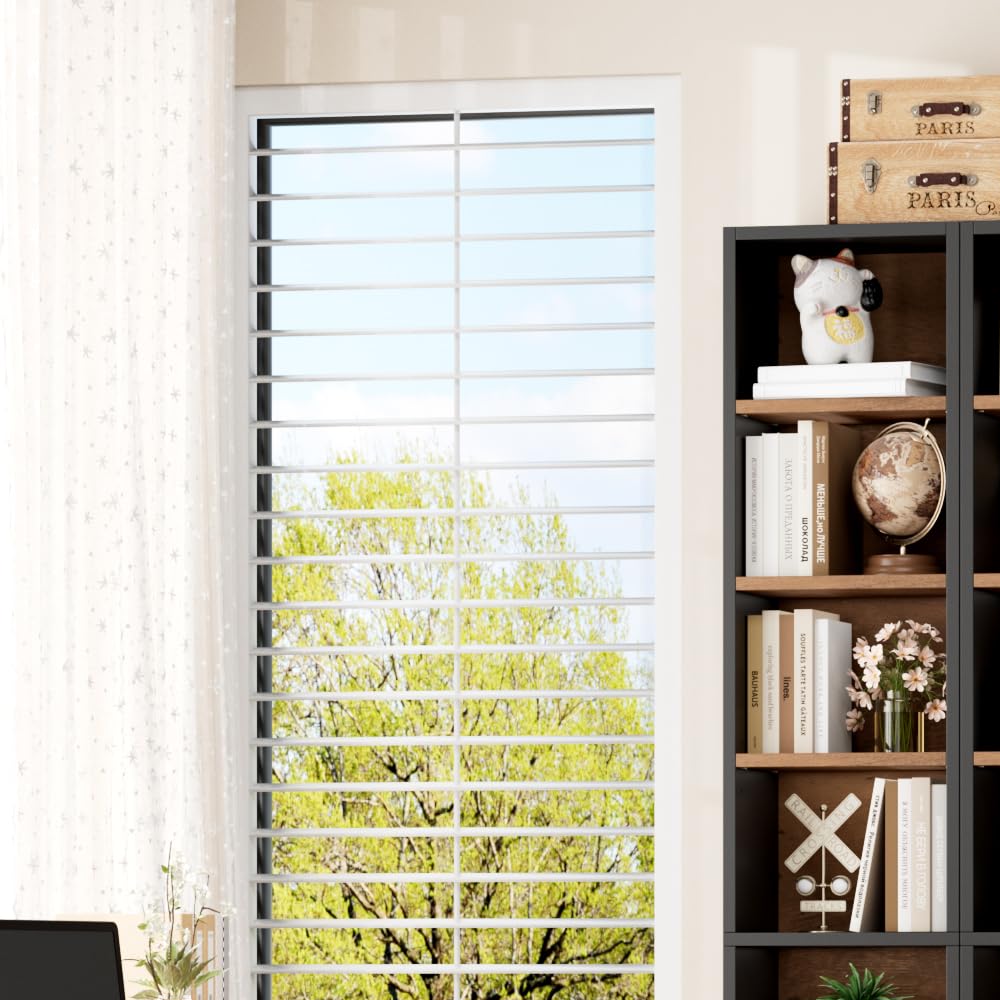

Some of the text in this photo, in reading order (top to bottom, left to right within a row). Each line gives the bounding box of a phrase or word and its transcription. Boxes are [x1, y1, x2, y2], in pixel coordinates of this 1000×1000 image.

[915, 121, 975, 136] PARIS
[906, 190, 977, 209] PARIS
[784, 457, 793, 492] ЗАБОТА
[801, 517, 809, 563] ШОКОЛАД
[815, 533, 826, 563] ЛУЧШЕ
